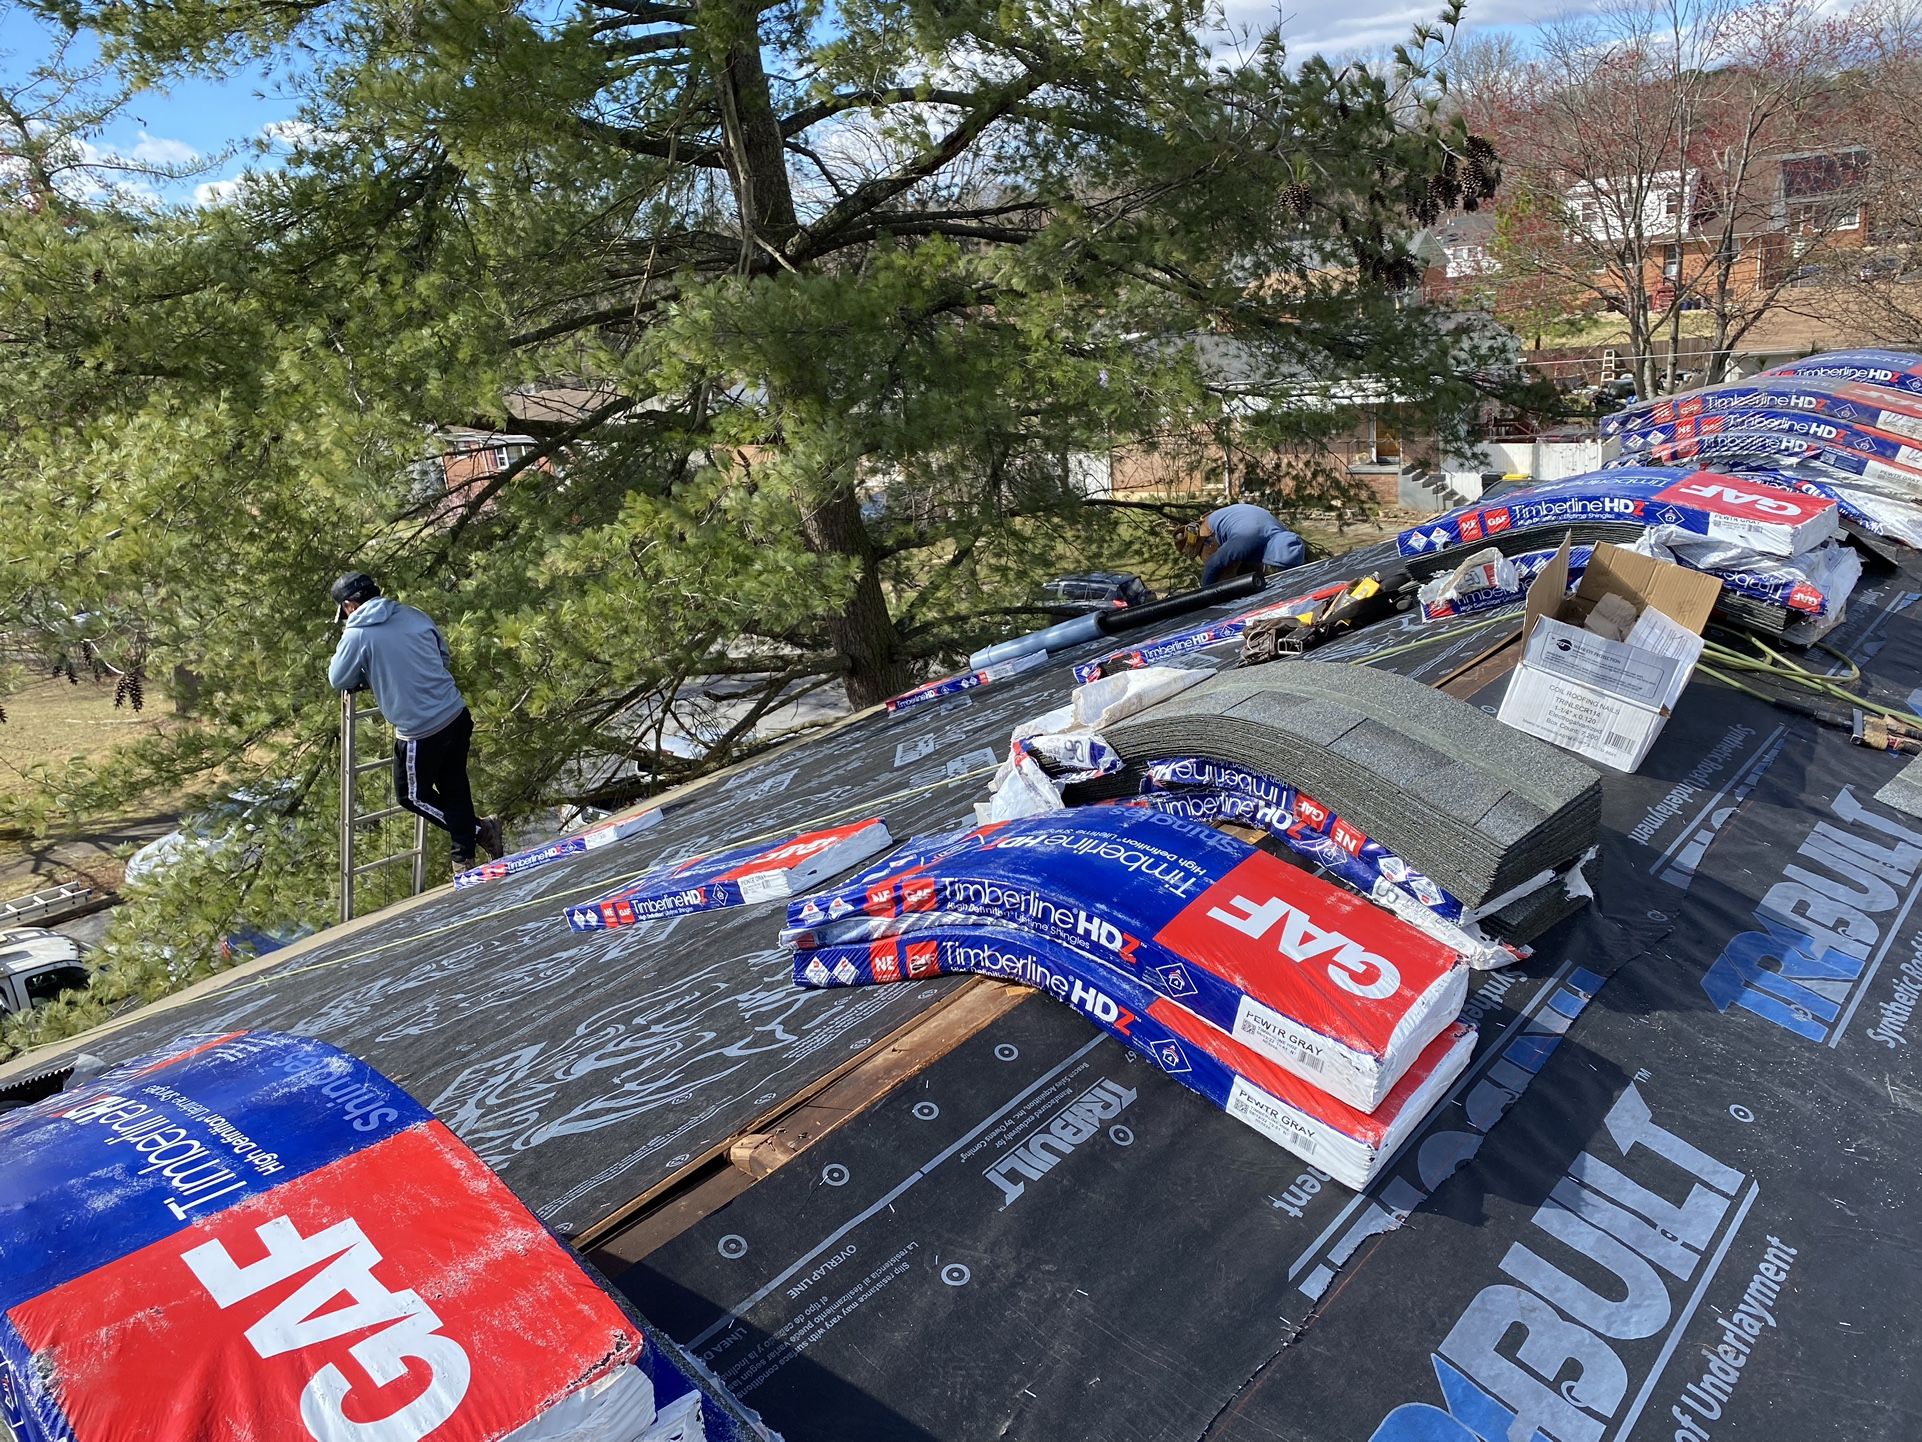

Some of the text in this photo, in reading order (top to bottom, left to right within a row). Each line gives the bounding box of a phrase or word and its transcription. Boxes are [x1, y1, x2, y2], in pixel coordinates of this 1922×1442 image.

[1679, 485, 1802, 516] GAF
[1713, 723, 1756, 761] Synthetic
[1297, 798, 1326, 822] GAF
[1627, 782, 1703, 846] Underlayment
[1335, 828, 1358, 851] NE
[1206, 894, 1401, 1000] GAF
[874, 956, 895, 971] NE
[1246, 1010, 1287, 1039] PEWTR
[1288, 1034, 1324, 1057] GRAY
[1067, 1061, 1089, 1078] Beacon
[994, 1086, 1072, 1148] Manufactured exclusively for
[1003, 1117, 1014, 1127] by
[1012, 1108, 1025, 1120] Inc.
[1239, 1089, 1279, 1120] PEWTR
[1281, 1114, 1316, 1138] GRAY
[984, 1124, 1006, 1142] Owens
[257, 1152, 285, 1177] High
[906, 1241, 917, 1251] La
[787, 1243, 856, 1298] OVERLAP LINE
[870, 1249, 908, 1280] resistencia
[893, 1260, 909, 1275] Slip
[857, 1272, 895, 1303] resistance
[863, 1277, 871, 1286] al
[803, 1301, 820, 1316] tipo
[813, 1284, 864, 1324] deslizamiento
[819, 1295, 828, 1304] el
[841, 1300, 858, 1315] may
[180, 1215, 471, 1442] GAF
[793, 1313, 805, 1325] de
[824, 1313, 842, 1329] vary
[1680, 1234, 1798, 1421] Underlayment
[788, 1321, 814, 1343] puede
[807, 1327, 826, 1343] with
